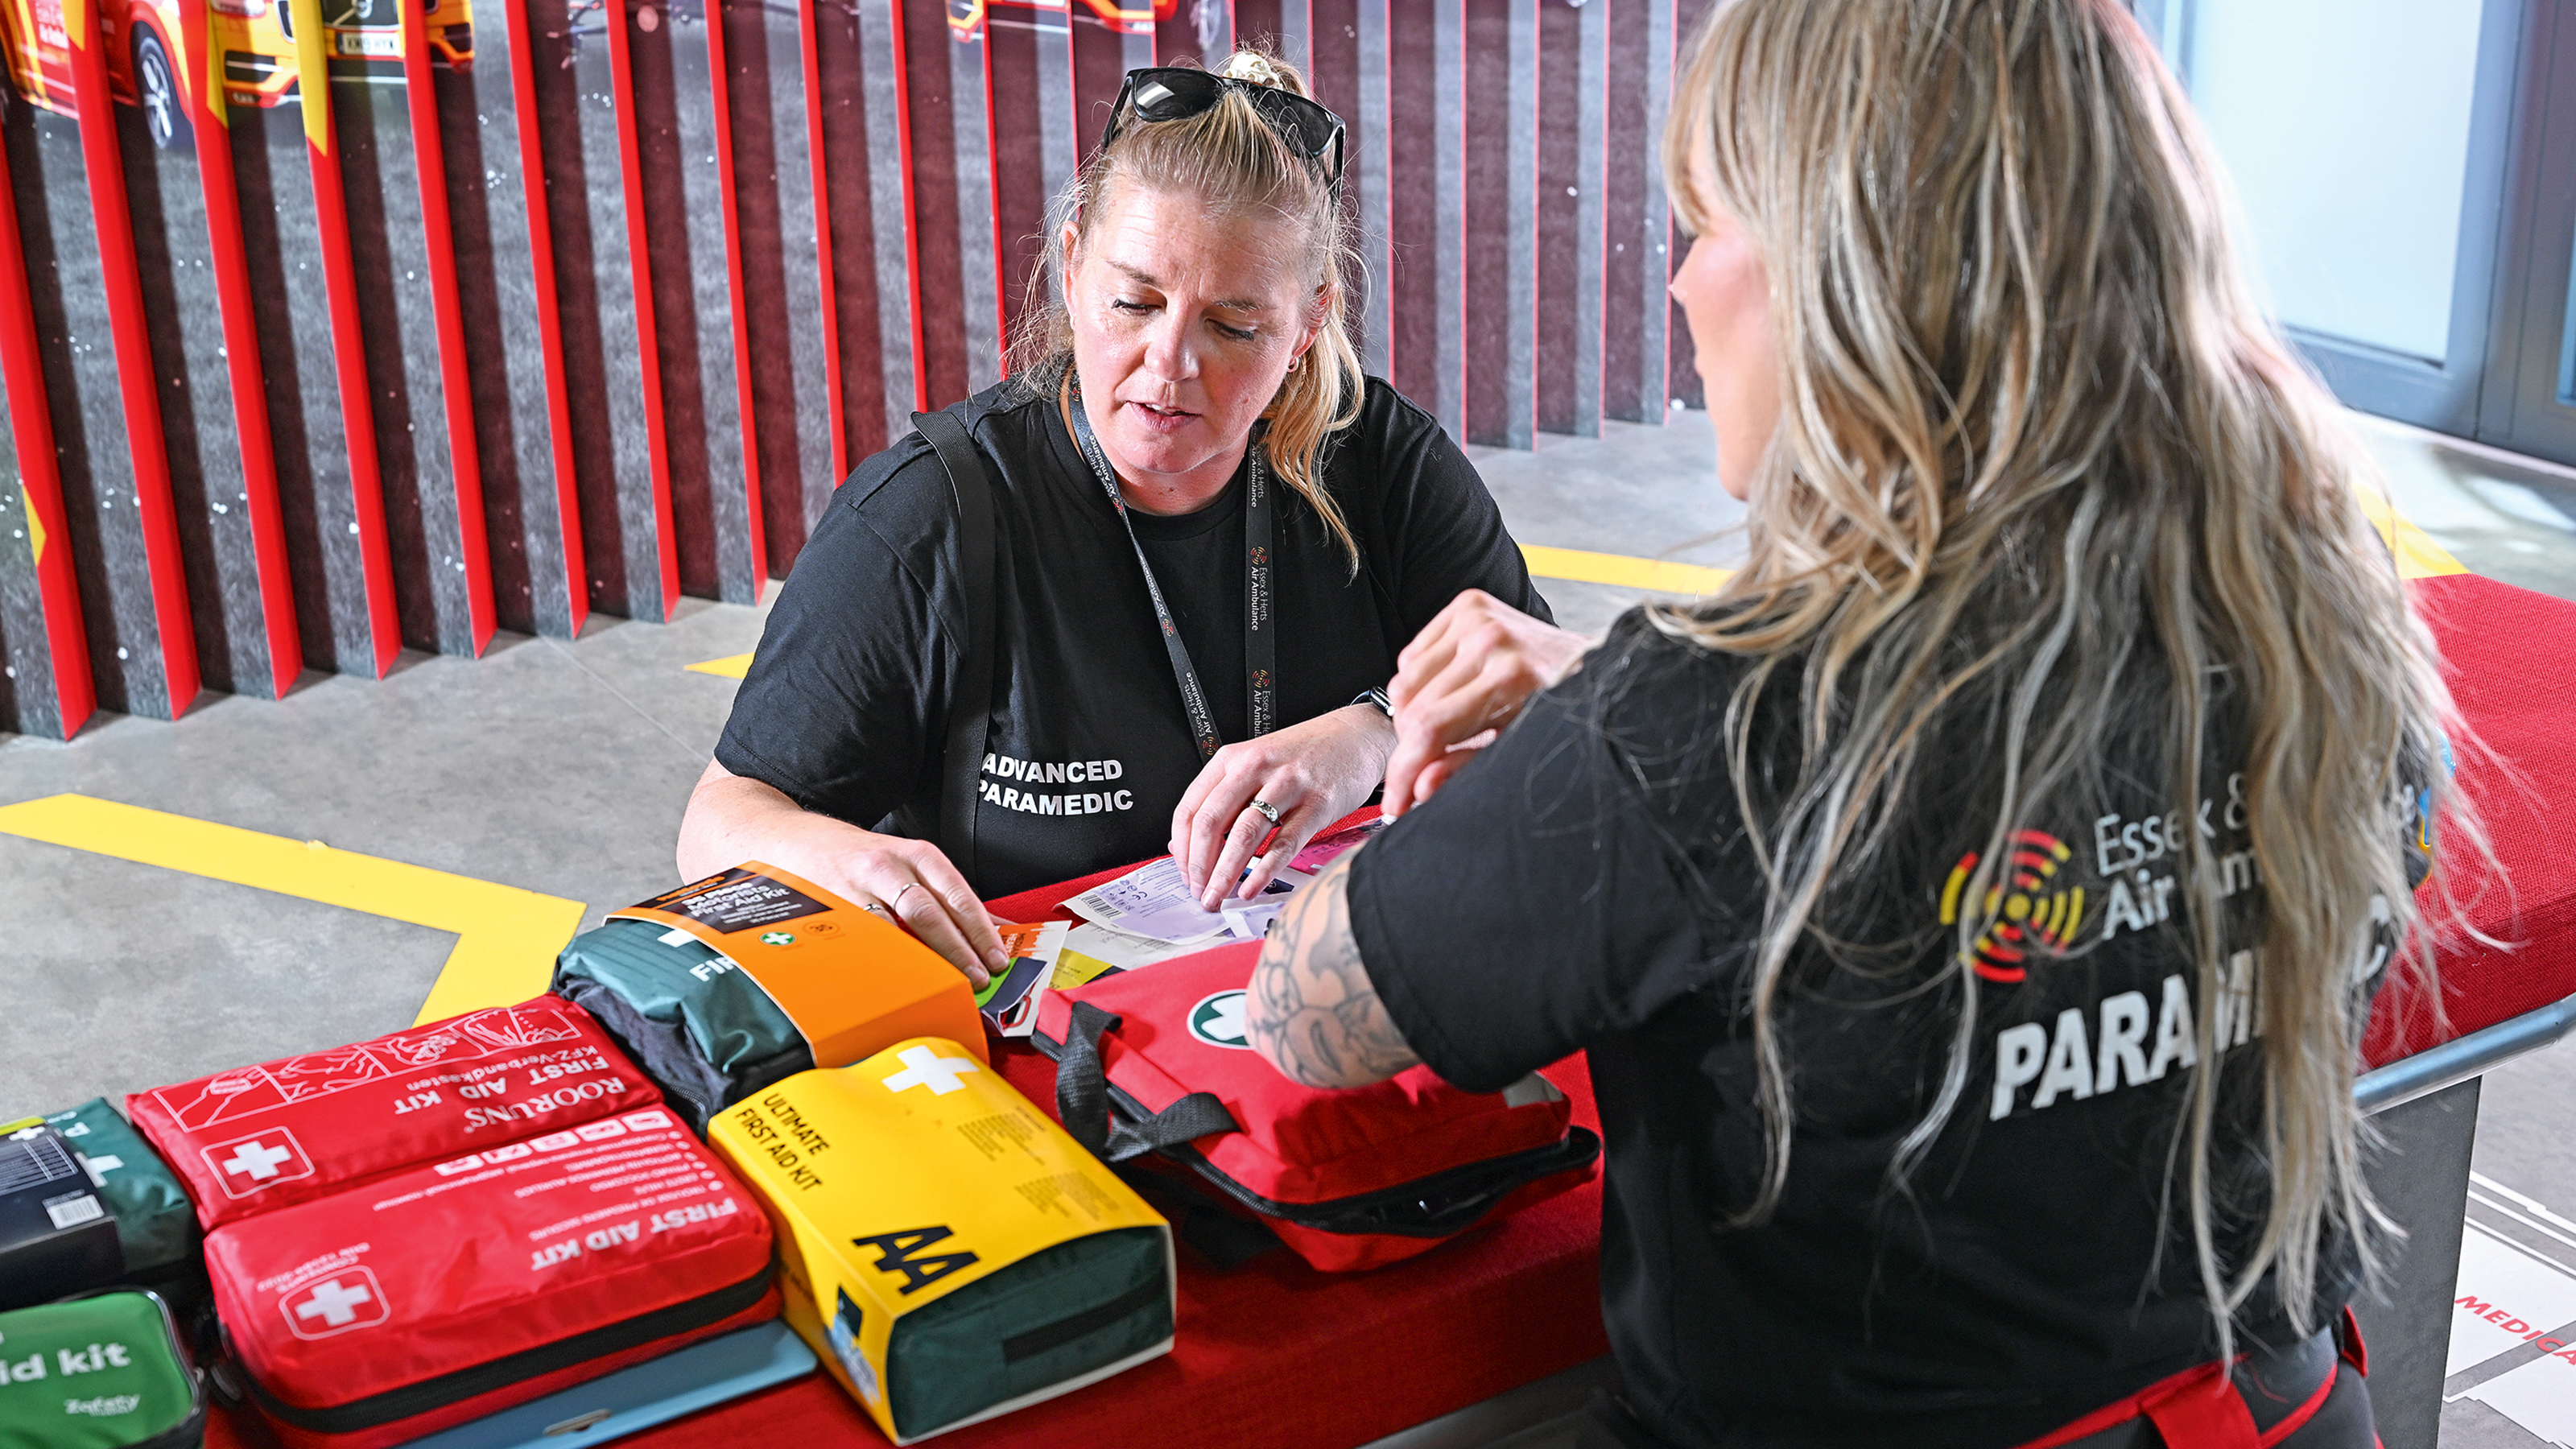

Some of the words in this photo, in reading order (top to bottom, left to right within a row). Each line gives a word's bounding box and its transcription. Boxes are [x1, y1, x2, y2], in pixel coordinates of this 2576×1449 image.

[1086, 447, 1098, 469] Herts
[1089, 435, 1111, 481] Ambulance
[1108, 482, 1117, 495] Air
[1251, 566, 1259, 580] Air
[1259, 567, 1268, 588] Essex
[1251, 580, 1260, 631] Ambulance
[1259, 589, 1269, 597] &
[1260, 598, 1269, 621] Herts
[1184, 683, 1195, 708] Herts
[1186, 671, 1208, 721] Ambulance
[1253, 689, 1262, 704] Air
[1261, 690, 1271, 712] Essex
[1191, 707, 1199, 715] &
[1253, 705, 1262, 738] Ambul
[1261, 712, 1271, 720] &
[1197, 716, 1207, 737] Essex
[1203, 720, 1213, 734] Air
[981, 753, 1123, 783] ADVANCED
[2095, 797, 2216, 877] Essex
[687, 885, 771, 912] Motorists
[691, 899, 733, 919] First
[734, 894, 764, 909] Aid
[764, 888, 791, 899] Kit
[2102, 868, 2174, 940] Air
[689, 956, 736, 982] FIR
[407, 1045, 598, 1091] KFZ-Verbandkasten
[528, 1056, 610, 1085] FIRST
[394, 1090, 442, 1115] KIT
[459, 1077, 507, 1099] AID
[464, 1077, 627, 1128] ROORUNS
[763, 1092, 830, 1156] ULTIMATE
[734, 1108, 778, 1145] FIRST
[765, 1144, 798, 1168] AID
[788, 1165, 823, 1191] KIT
[649, 1197, 739, 1233] FIRST
[584, 1219, 641, 1251] AID
[530, 1238, 583, 1272] KIT
[851, 1224, 980, 1296] AA
[2454, 1295, 2576, 1366] MEDICA
[0, 1352, 47, 1386] id
[56, 1342, 131, 1377] kit
